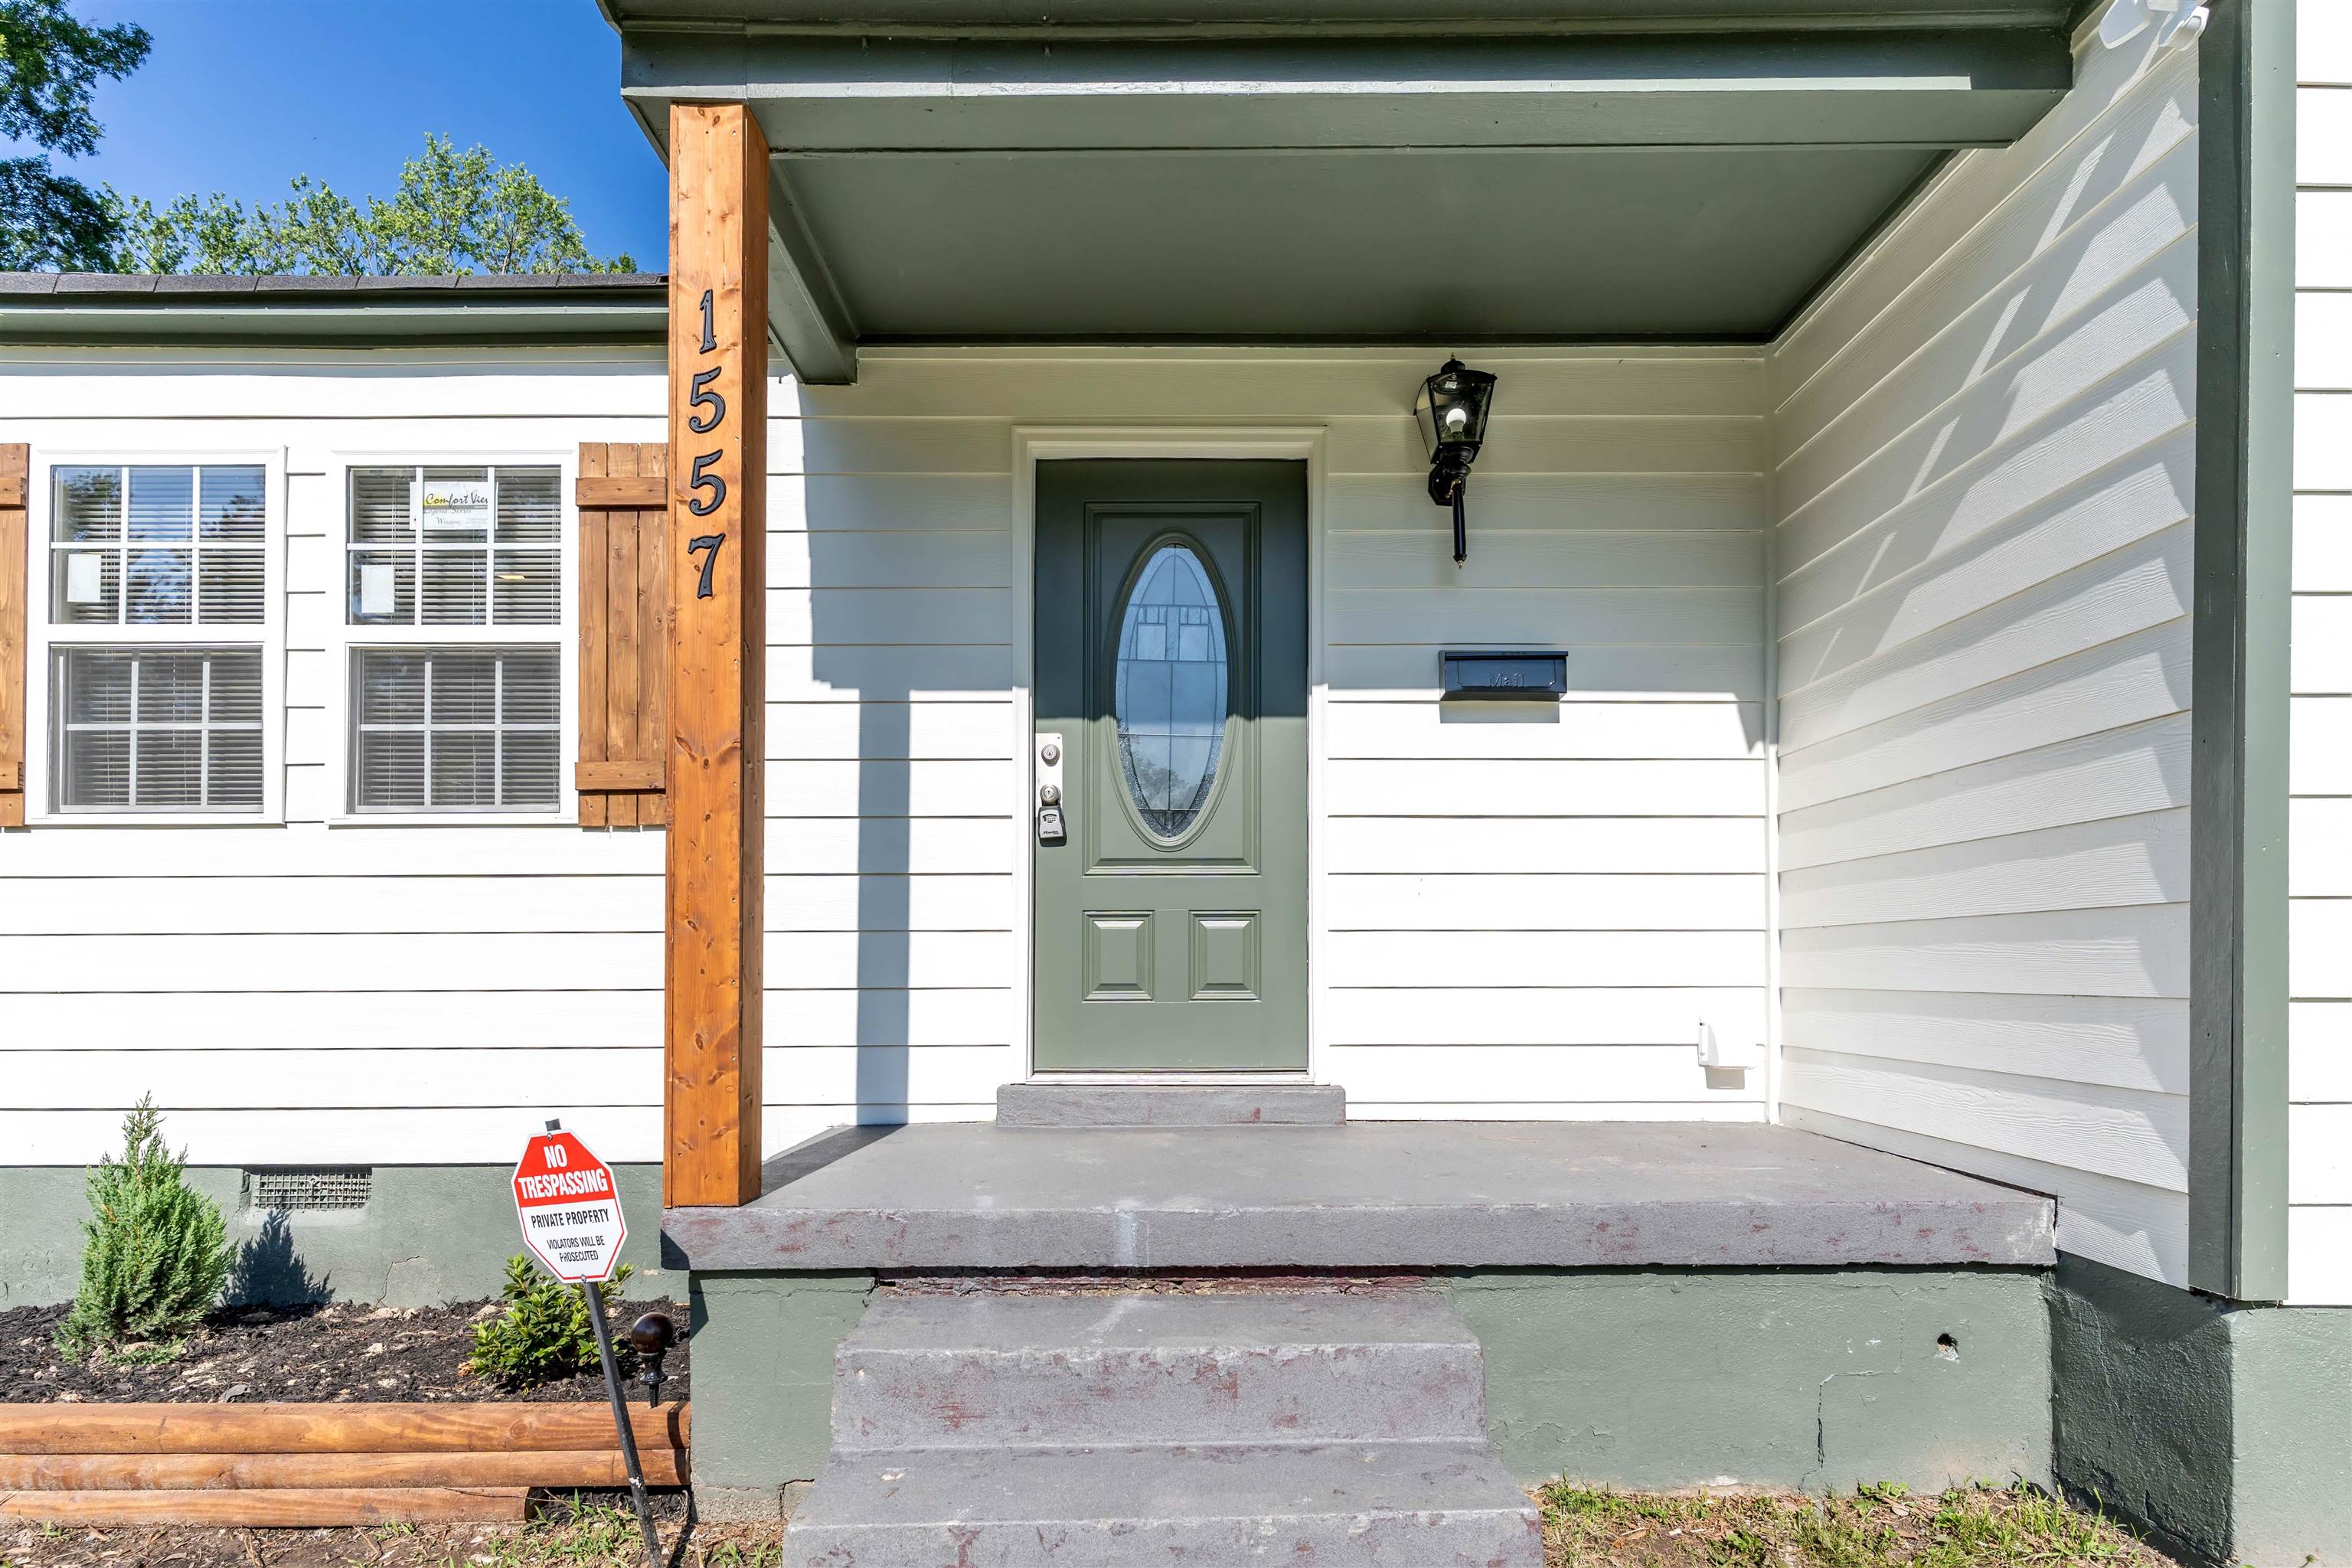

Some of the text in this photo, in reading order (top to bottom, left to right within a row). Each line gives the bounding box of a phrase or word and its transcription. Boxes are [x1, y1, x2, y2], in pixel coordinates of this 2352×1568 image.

[688, 288, 727, 599] 1557
[426, 493, 469, 508] Comfort
[1487, 674, 1524, 687] Mail
[544, 1144, 567, 1168] NO
[518, 1168, 609, 1199] TRESPASSING
[531, 1208, 609, 1228] PRIVATE PROPERTY
[547, 1235, 605, 1250] VIOLATORS WILL BE
[559, 1250, 599, 1263] PROSECUTED
